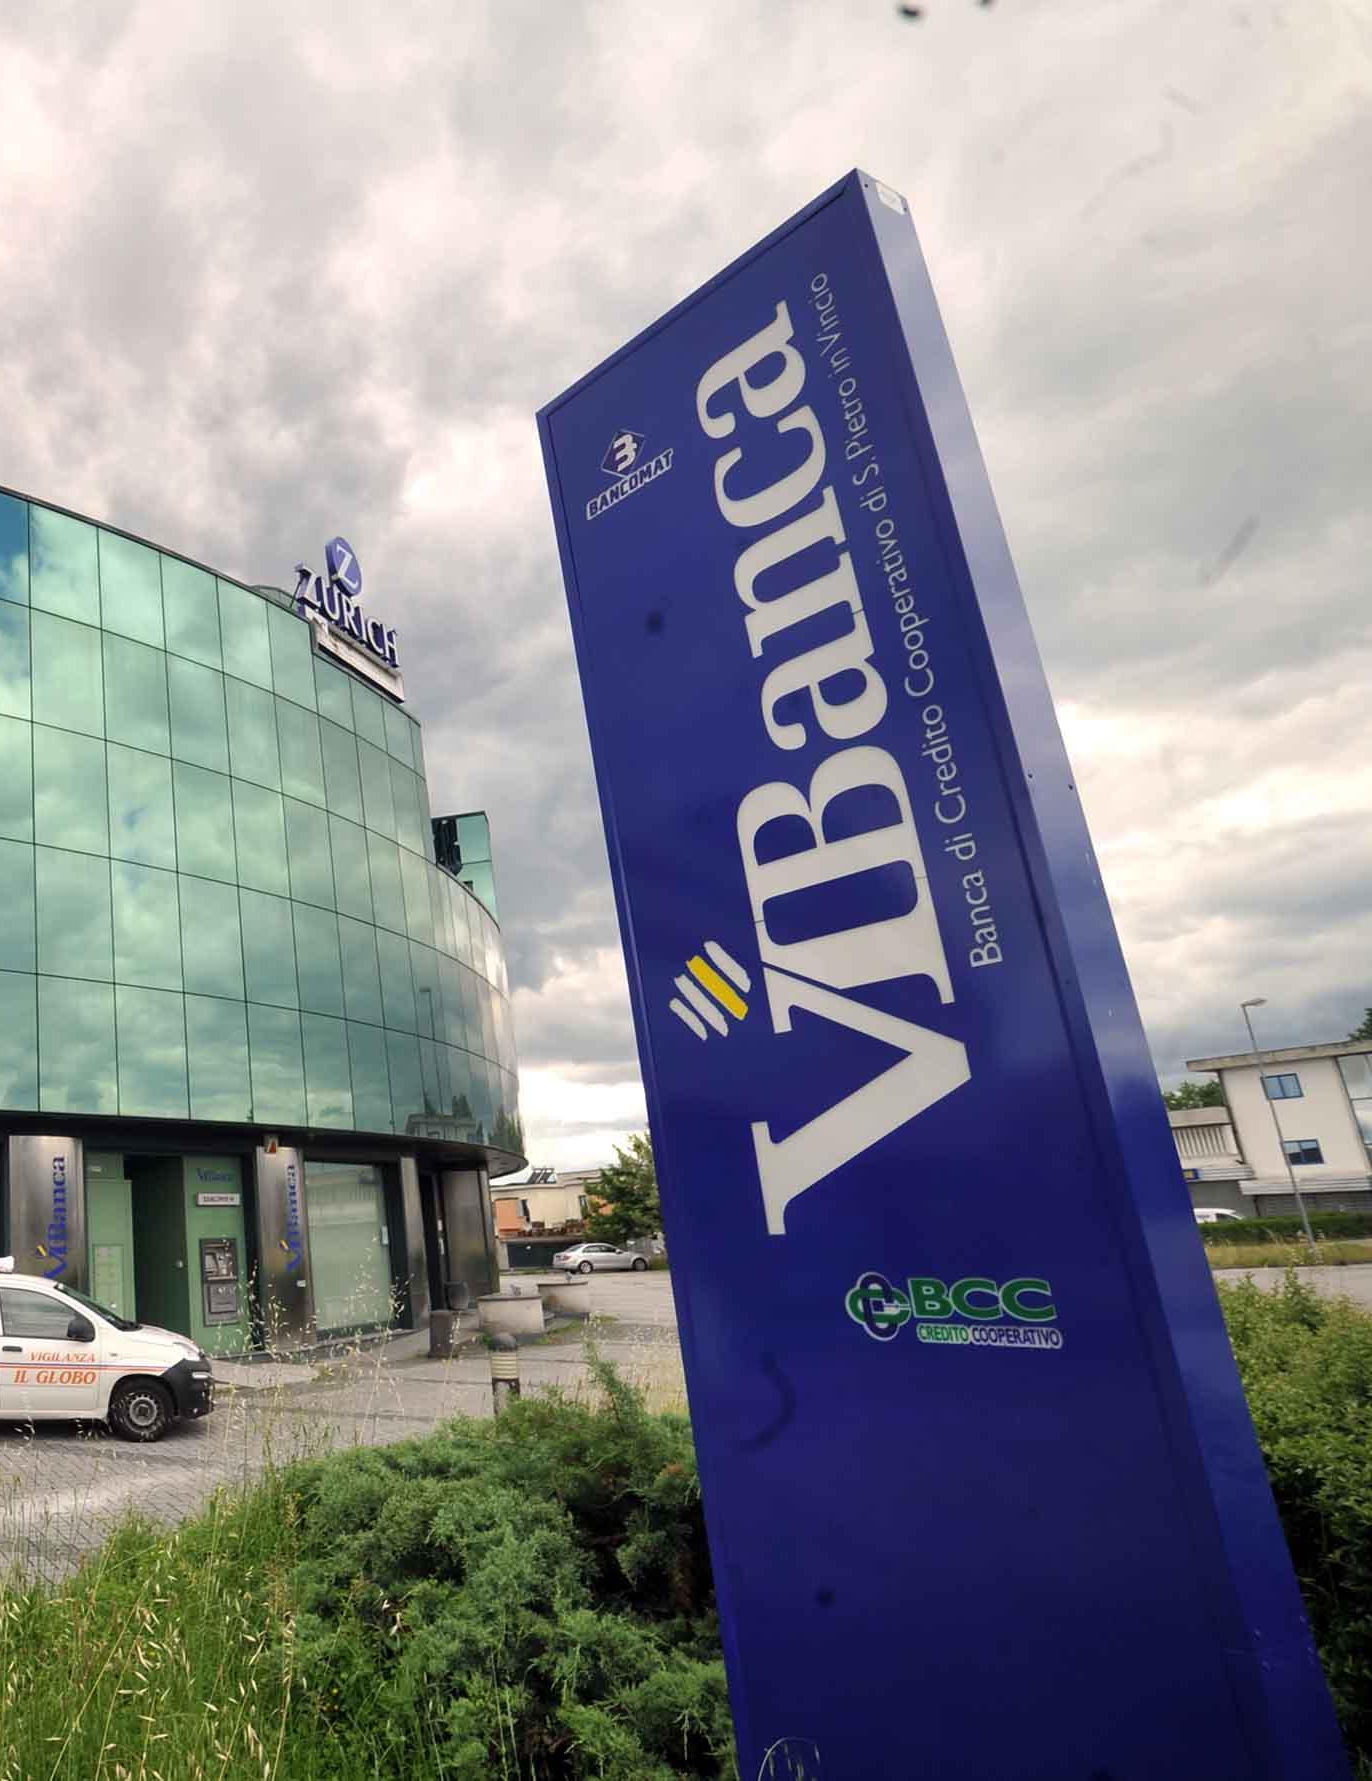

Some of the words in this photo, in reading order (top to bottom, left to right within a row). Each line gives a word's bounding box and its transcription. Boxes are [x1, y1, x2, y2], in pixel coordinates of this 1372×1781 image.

[808, 272, 843, 357] Vincio
[827, 346, 852, 378] in
[838, 377, 873, 460] Pietro
[587, 448, 674, 520] BANCOMAT
[853, 455, 879, 486] S.
[859, 485, 887, 512] di
[295, 564, 399, 668] ZURICH
[875, 519, 935, 697] Cooperativo
[921, 703, 966, 825] Credito
[944, 831, 976, 861] di
[961, 869, 1003, 968] Banca
[908, 1278, 1058, 1321] BCC
[30, 1351, 96, 1363] VIGILANZA
[918, 1324, 969, 1342] CREDITO
[971, 1327, 1061, 1348] COOPERATIVO
[14, 1369, 30, 1384] IL
[36, 1370, 96, 1385] GLOBO
